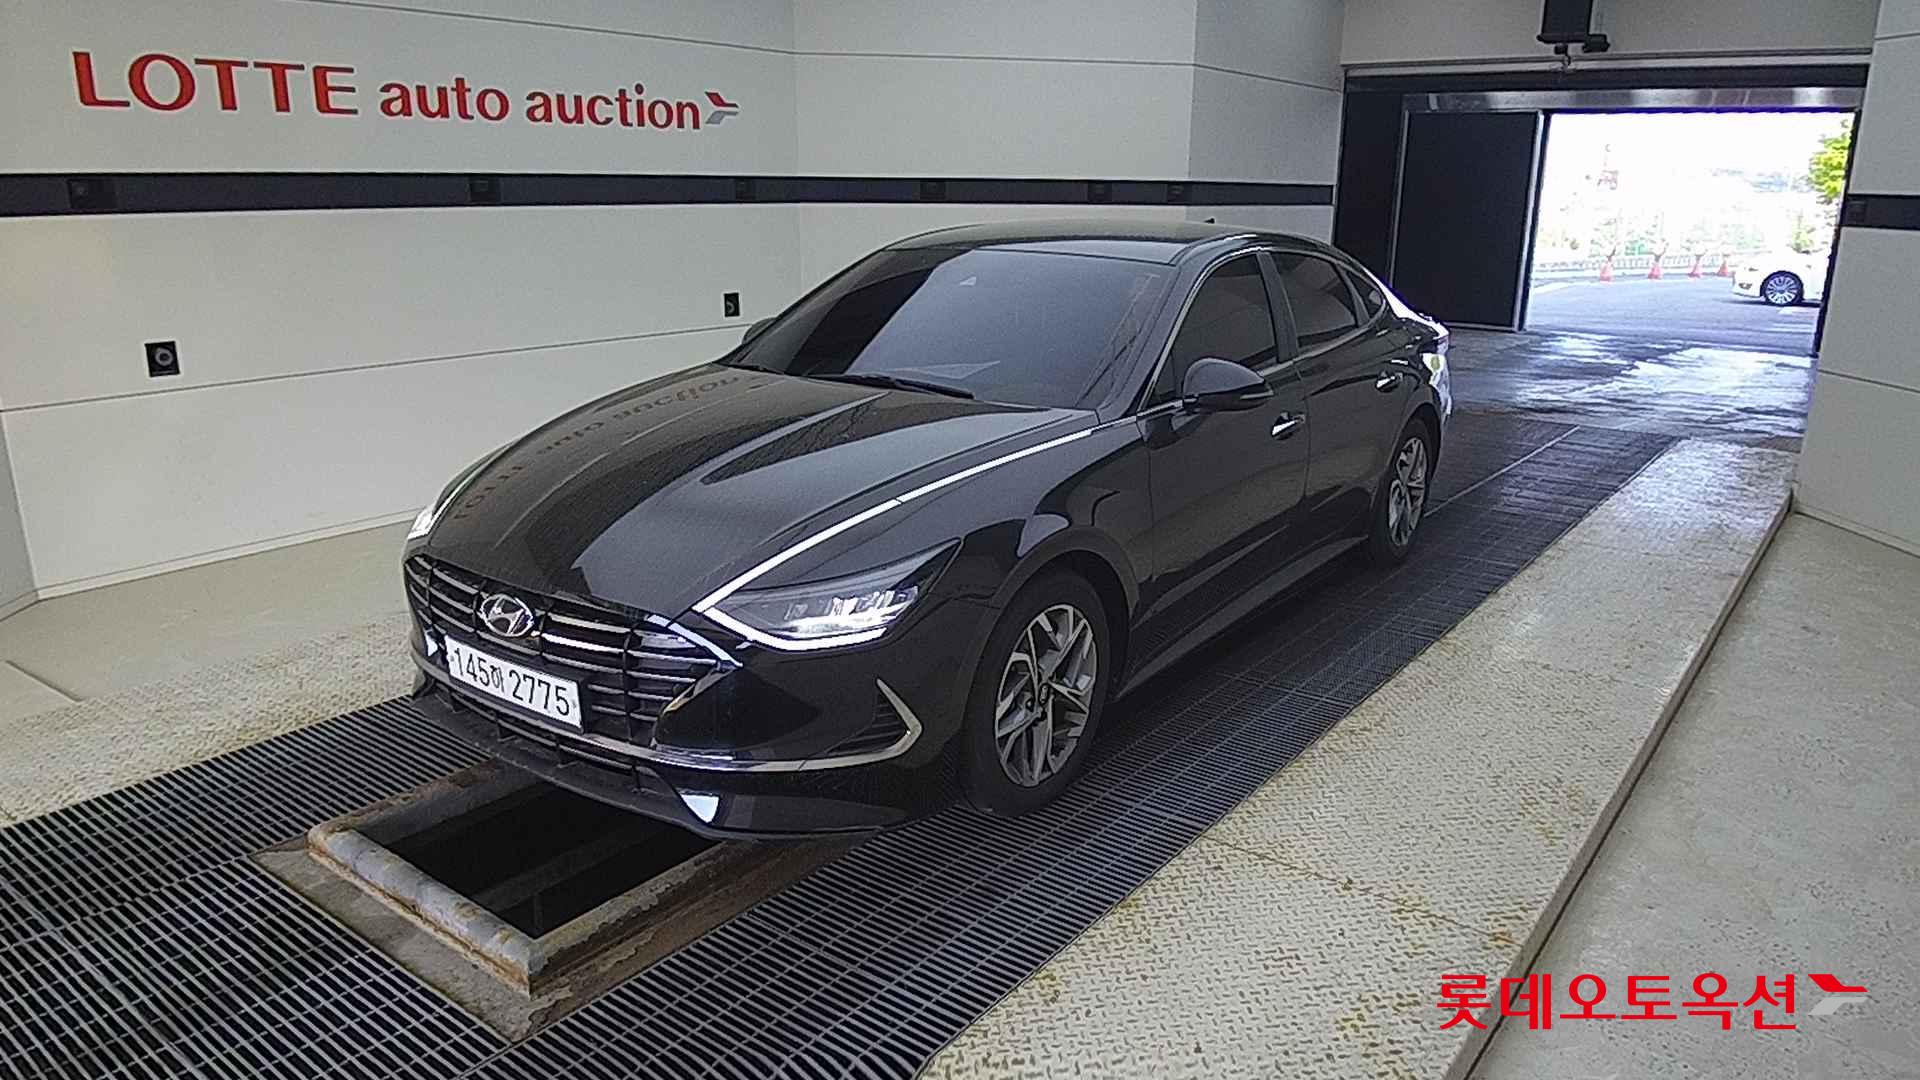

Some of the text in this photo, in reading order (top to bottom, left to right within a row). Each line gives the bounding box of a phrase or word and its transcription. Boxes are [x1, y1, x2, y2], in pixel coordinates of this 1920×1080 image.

[72, 51, 701, 130] LOTTE auto auction
[508, 669, 570, 716] 2775
